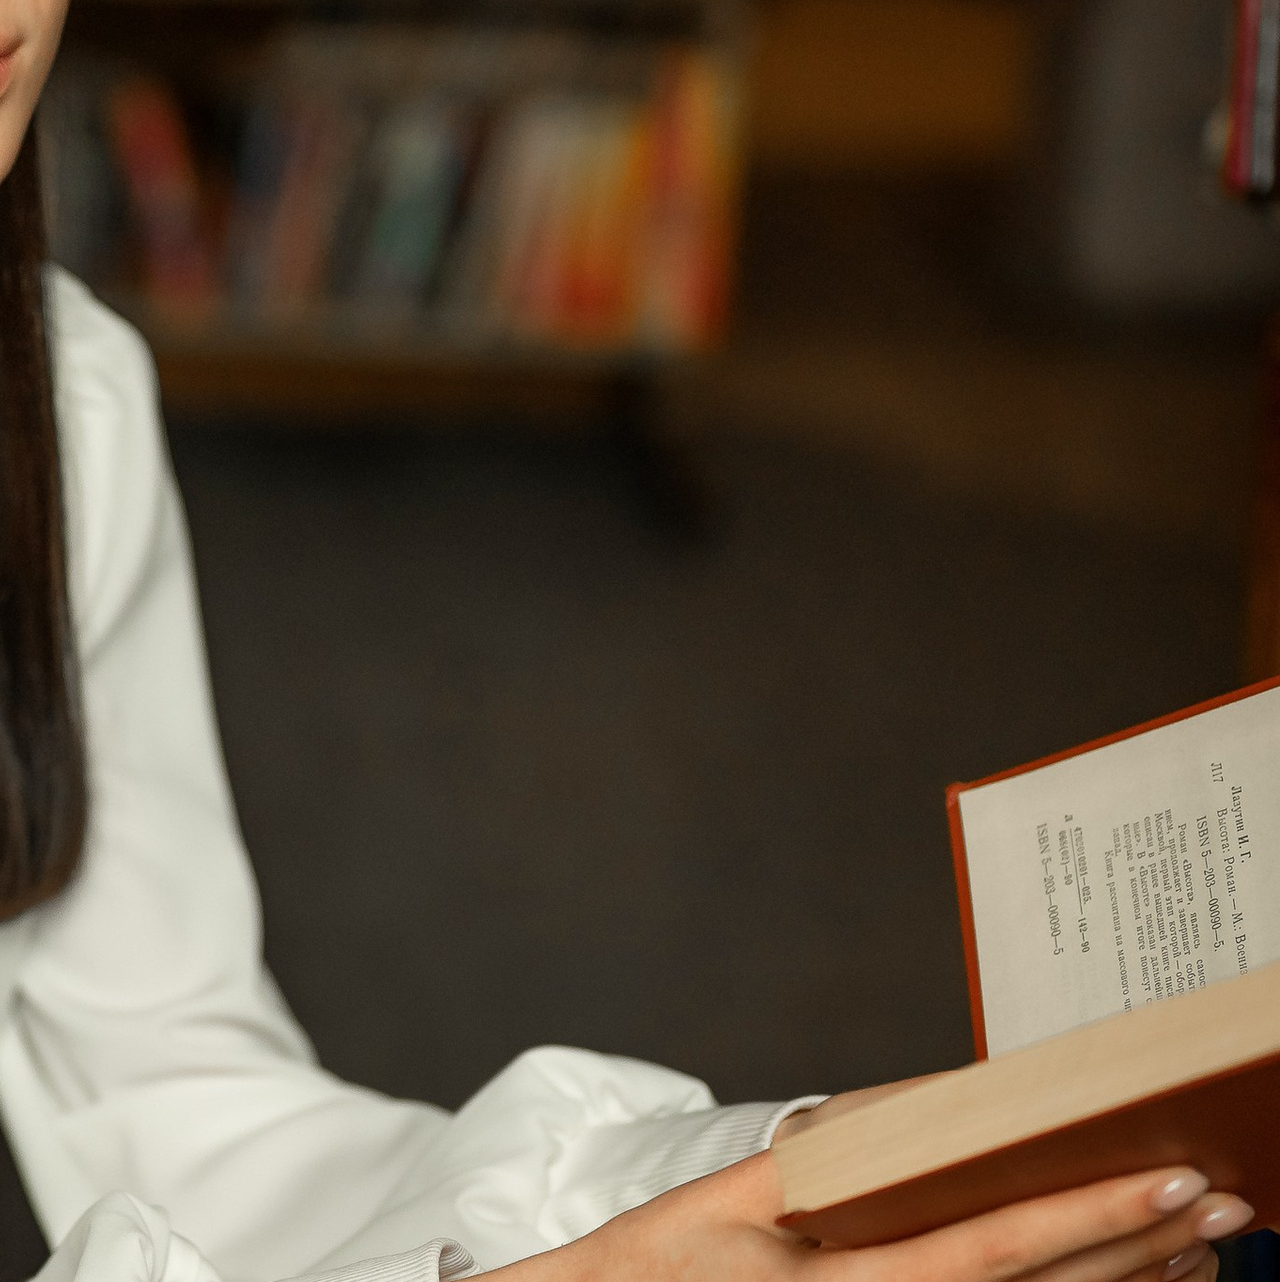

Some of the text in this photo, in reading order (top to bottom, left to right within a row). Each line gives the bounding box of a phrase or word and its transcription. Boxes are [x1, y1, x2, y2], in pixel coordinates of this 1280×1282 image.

[1210, 762, 1224, 783] Л17
[1036, 822, 1051, 855] ISBN
[1122, 822, 1134, 862] которые
[1143, 816, 1154, 848] описан
[1154, 812, 1170, 856] Москвой,
[1177, 822, 1188, 854] Роман
[1196, 815, 1211, 847] ISBN
[1216, 807, 1231, 854] Высота:
[1230, 786, 1252, 864] Лазутин И. Г.
[1104, 849, 1114, 879] Книга
[1136, 850, 1146, 860] В
[1139, 864, 1150, 908] «Высоте»
[1147, 862, 1159, 889] ранее
[1159, 858, 1173, 893] первый
[1182, 858, 1194, 906] «Высота»,
[1223, 856, 1237, 897] Роман.
[1105, 881, 1122, 932] рассчитана
[1129, 877, 1142, 921] конечном
[1153, 892, 1168, 942] вышедшей
[1165, 895, 1174, 917] этап
[1166, 837, 1183, 893] продолжает
[1178, 908, 1191, 956] завершает
[1185, 962, 1197, 990] событ
[1136, 925, 1146, 951] итоге
[1145, 913, 1157, 951] показан
[1168, 920, 1182, 959] которой
[1190, 912, 1201, 950] являясь
[1231, 911, 1244, 932] М.:
[1115, 934, 1123, 947] на
[1160, 945, 1170, 972] книге
[1117, 949, 1130, 996] массового
[1140, 955, 1152, 992] понесут
